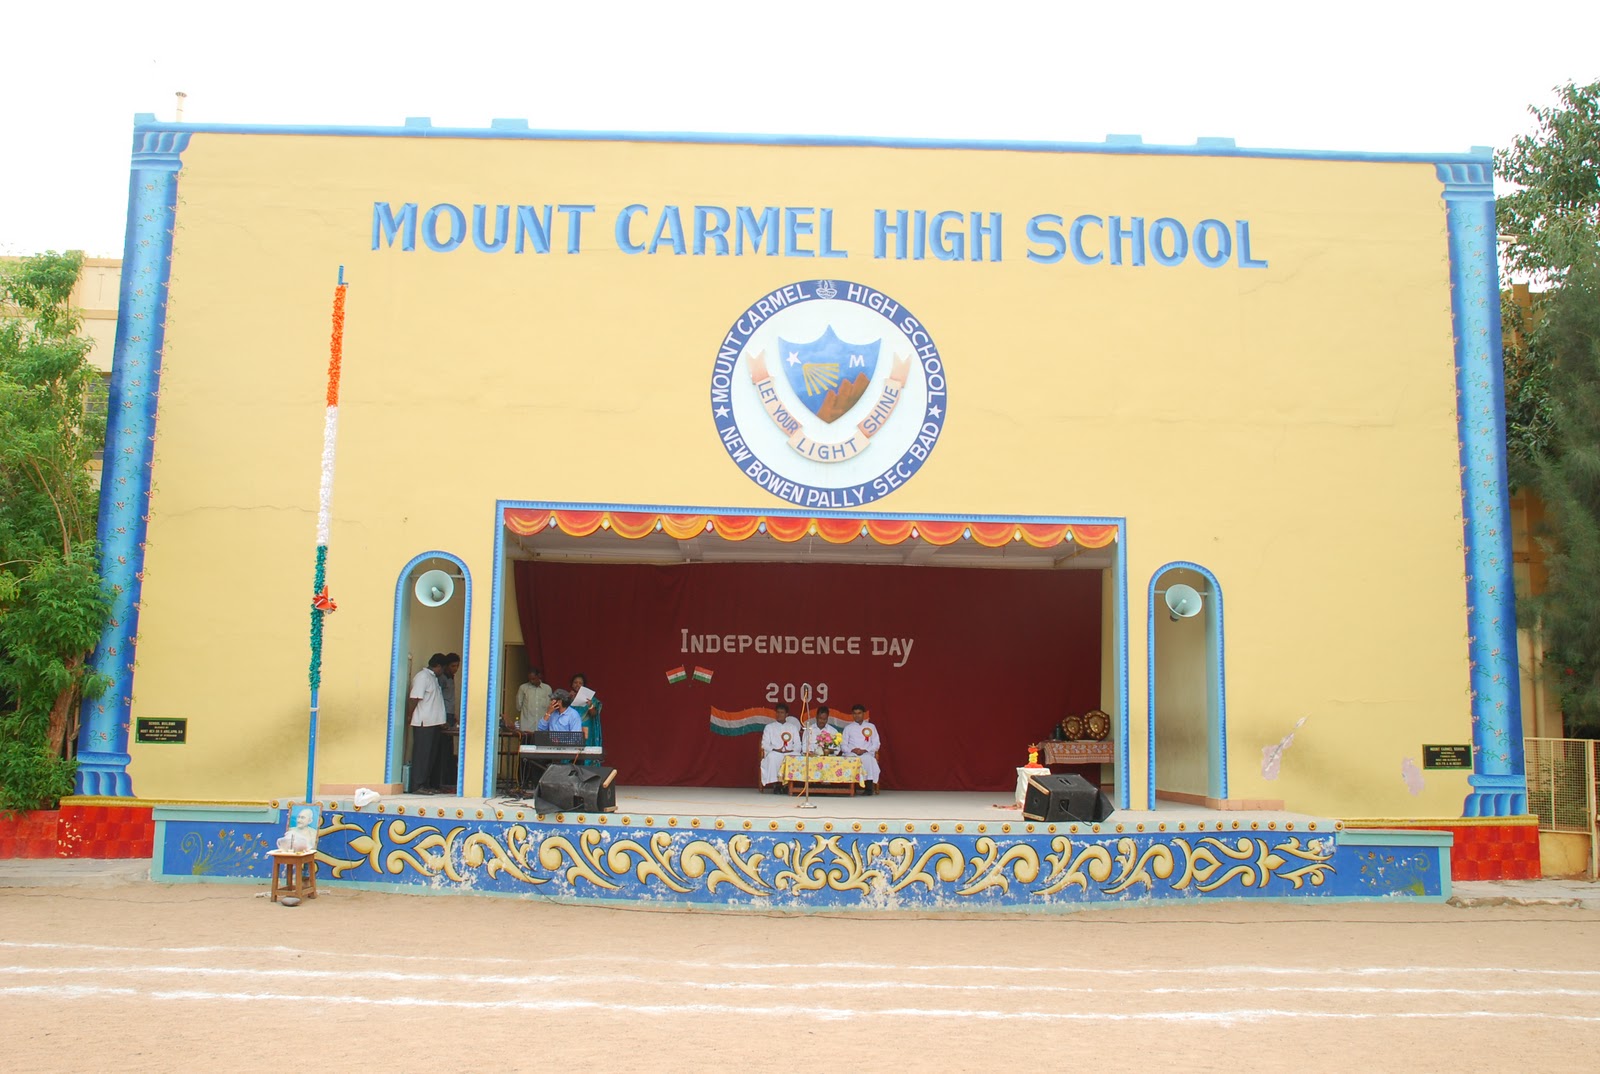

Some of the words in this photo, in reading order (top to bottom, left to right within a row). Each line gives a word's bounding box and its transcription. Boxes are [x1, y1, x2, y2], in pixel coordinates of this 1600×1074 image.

[371, 202, 596, 254] MOUNT
[614, 203, 848, 258] CARMEL
[874, 208, 1002, 262] HIGH
[1025, 213, 1268, 269] SCHOOL
[712, 331, 742, 403] MOUNT
[737, 283, 811, 335] CARMEL
[847, 283, 899, 319] HIGH
[899, 317, 945, 404] SCHOOL
[849, 354, 865, 368] M
[757, 380, 778, 404] LET
[772, 402, 800, 434] YOUR
[796, 438, 858, 459] LIGHT
[864, 385, 899, 434] SHINE
[720, 426, 753, 463] NEW
[745, 460, 803, 503] BOWEN
[680, 628, 861, 655] INDEPENDENCE
[765, 682, 829, 703] 2009
